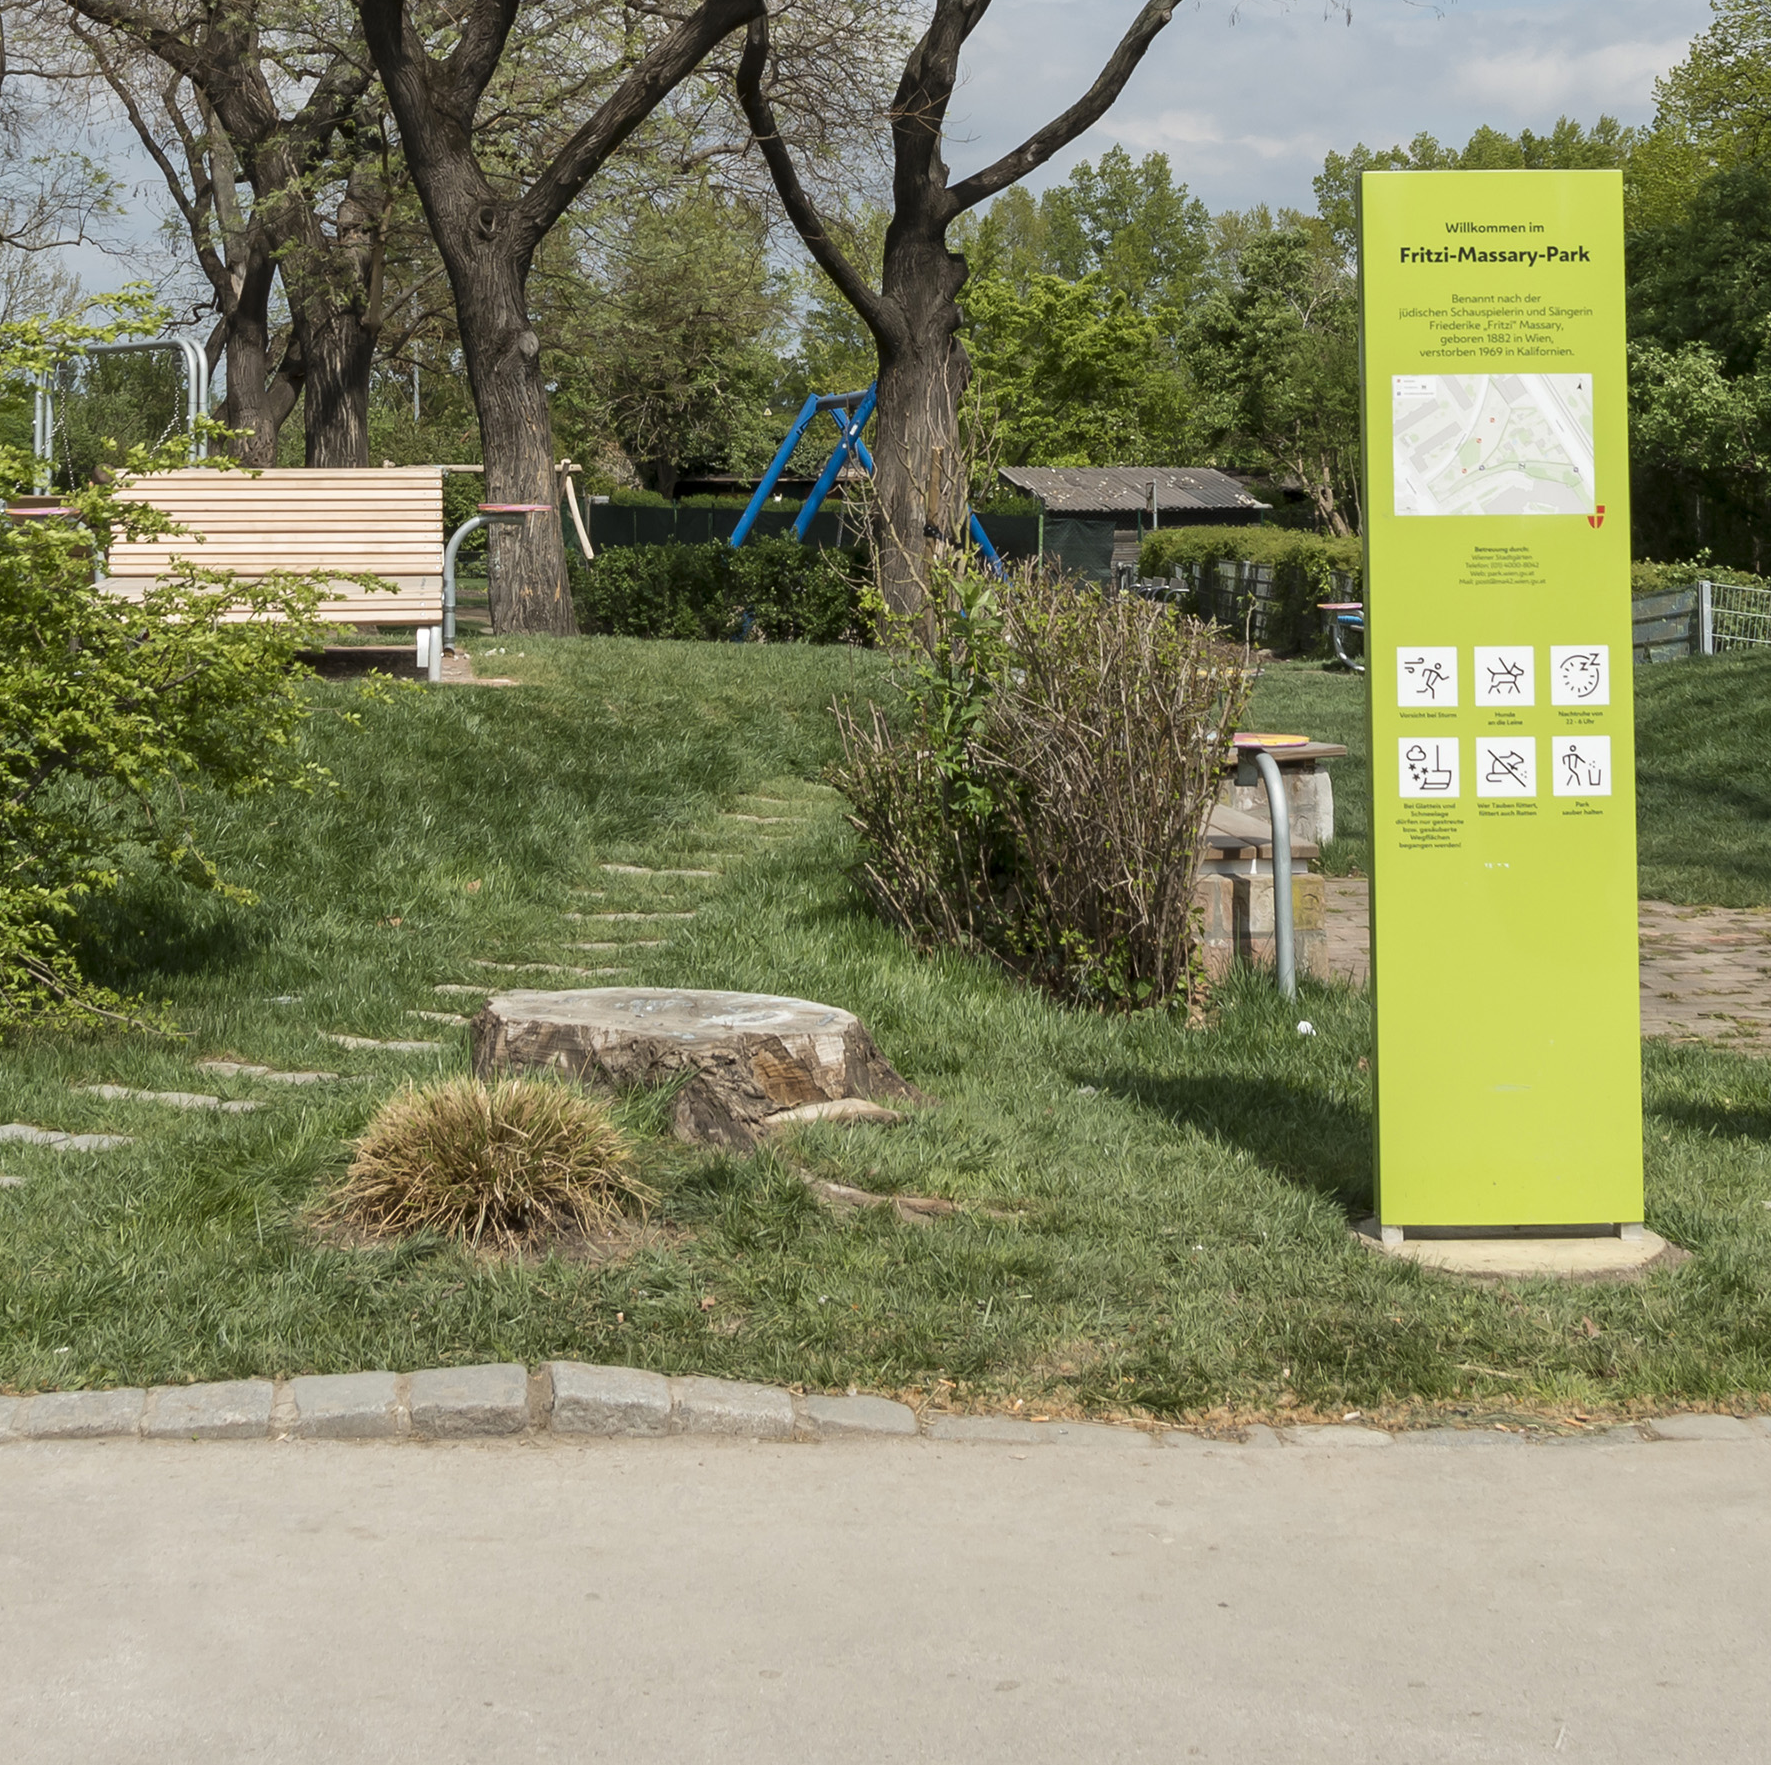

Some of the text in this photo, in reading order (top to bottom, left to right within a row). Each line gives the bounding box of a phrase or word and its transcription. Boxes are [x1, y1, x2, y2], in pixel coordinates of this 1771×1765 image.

[1445, 222, 1544, 233] Willkommen im
[1401, 246, 1590, 267] Fritzi-Massary-Park
[1452, 294, 1541, 303] Benannt nach der
[1399, 307, 1593, 319] jüdischen Schauspielerin und Sängerin
[1430, 321, 1481, 330] Friederike
[1520, 320, 1564, 332] Massary,
[1441, 334, 1554, 346] geboren 1882 in Wien,
[1420, 347, 1574, 357] verstorben 1969 in Kalifornien.
[1399, 842, 1433, 850] begangen
